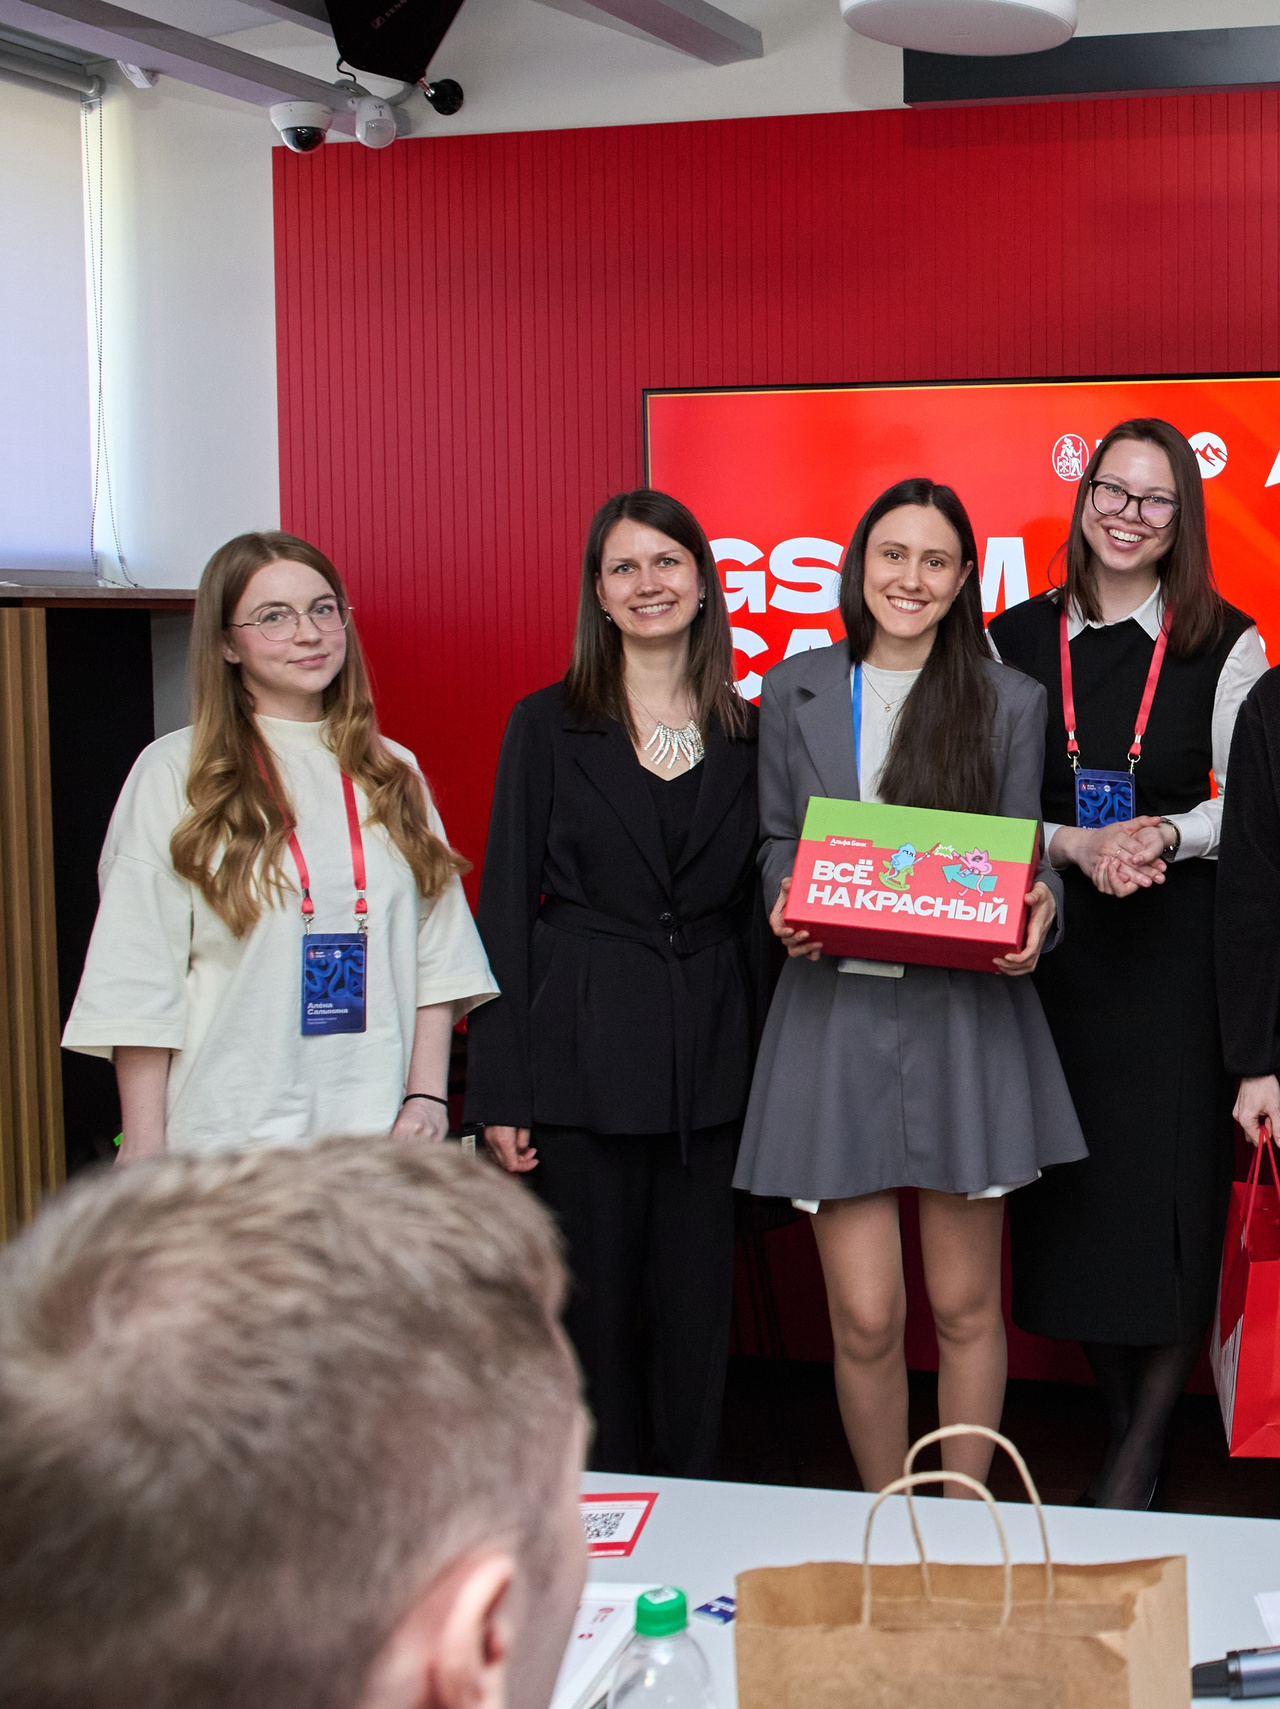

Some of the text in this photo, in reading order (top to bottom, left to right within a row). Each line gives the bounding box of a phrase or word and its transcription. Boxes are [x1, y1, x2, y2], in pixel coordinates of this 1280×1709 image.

[709, 537, 1029, 614] GSM
[830, 838, 867, 848] Альфа Банк
[812, 859, 874, 885] ВСЁ
[807, 884, 1008, 925] НА КРАСНЫЙ
